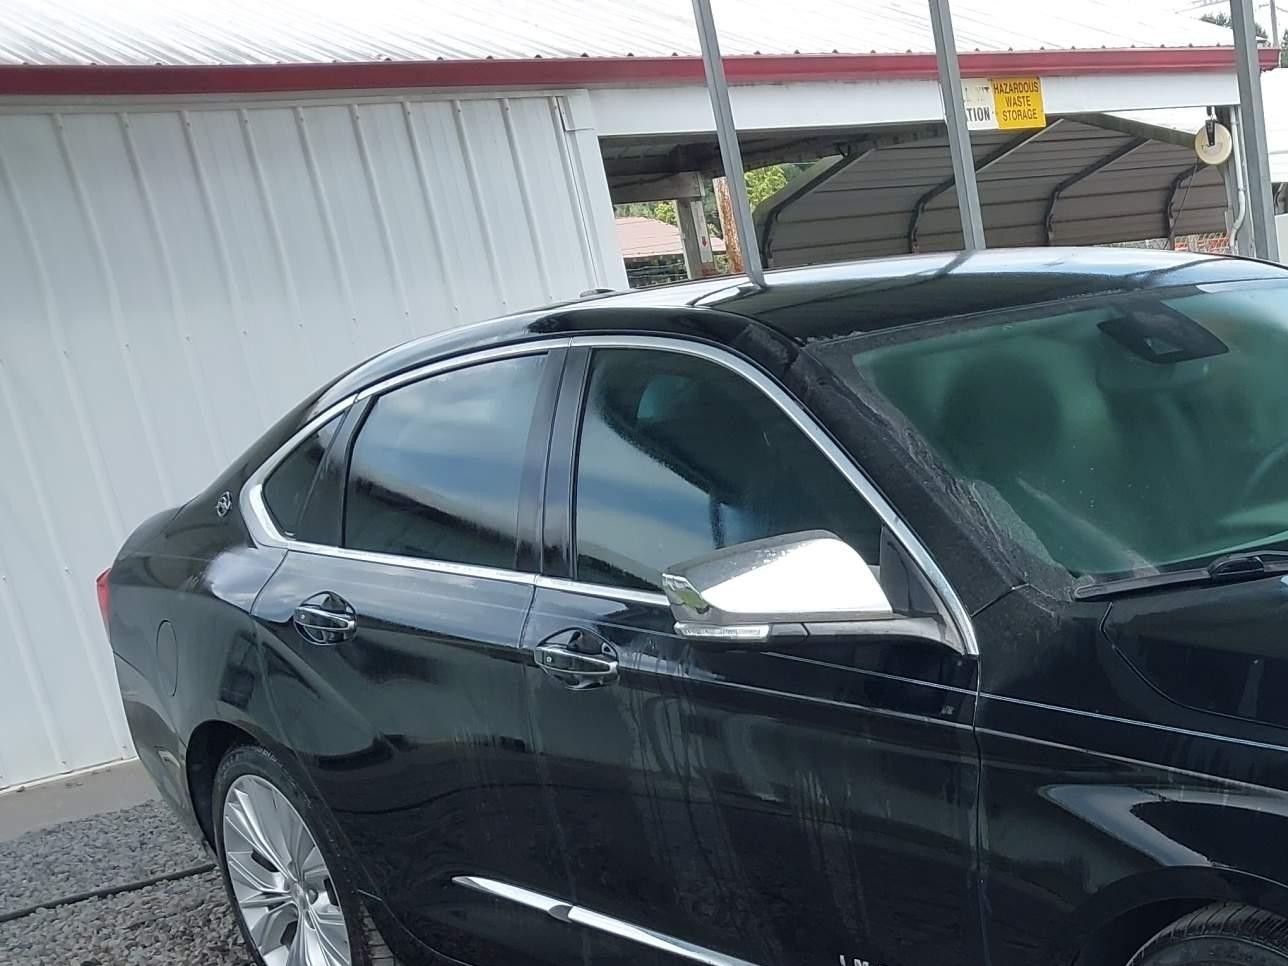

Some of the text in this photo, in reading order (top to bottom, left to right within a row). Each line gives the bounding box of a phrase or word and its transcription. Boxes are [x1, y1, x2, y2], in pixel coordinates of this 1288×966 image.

[993, 81, 1039, 94] HAZARDOUS
[1005, 96, 1031, 107] WASTE
[1002, 109, 1038, 121] STORAGE
